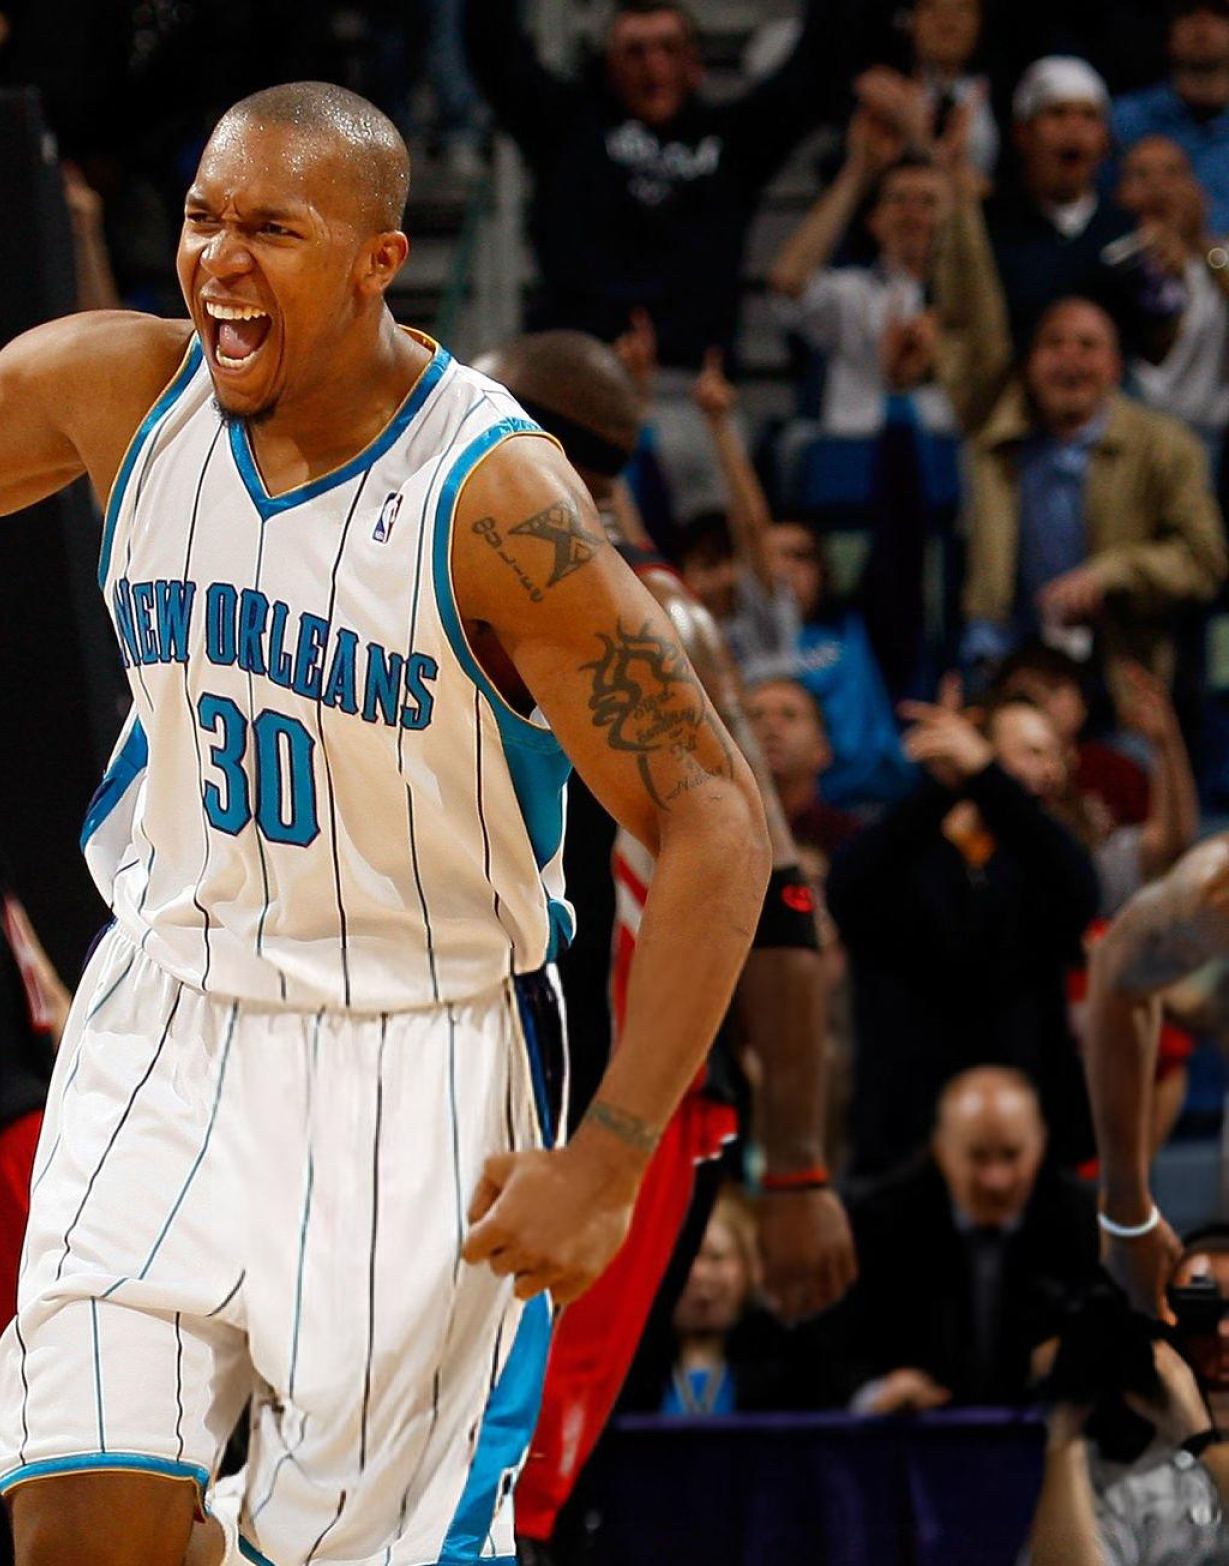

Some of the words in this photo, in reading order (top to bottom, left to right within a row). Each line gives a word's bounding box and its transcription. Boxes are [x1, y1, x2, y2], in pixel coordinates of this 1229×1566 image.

[113, 577, 197, 669] NEW
[205, 581, 439, 731] ORLEANS
[196, 691, 322, 848] 30
